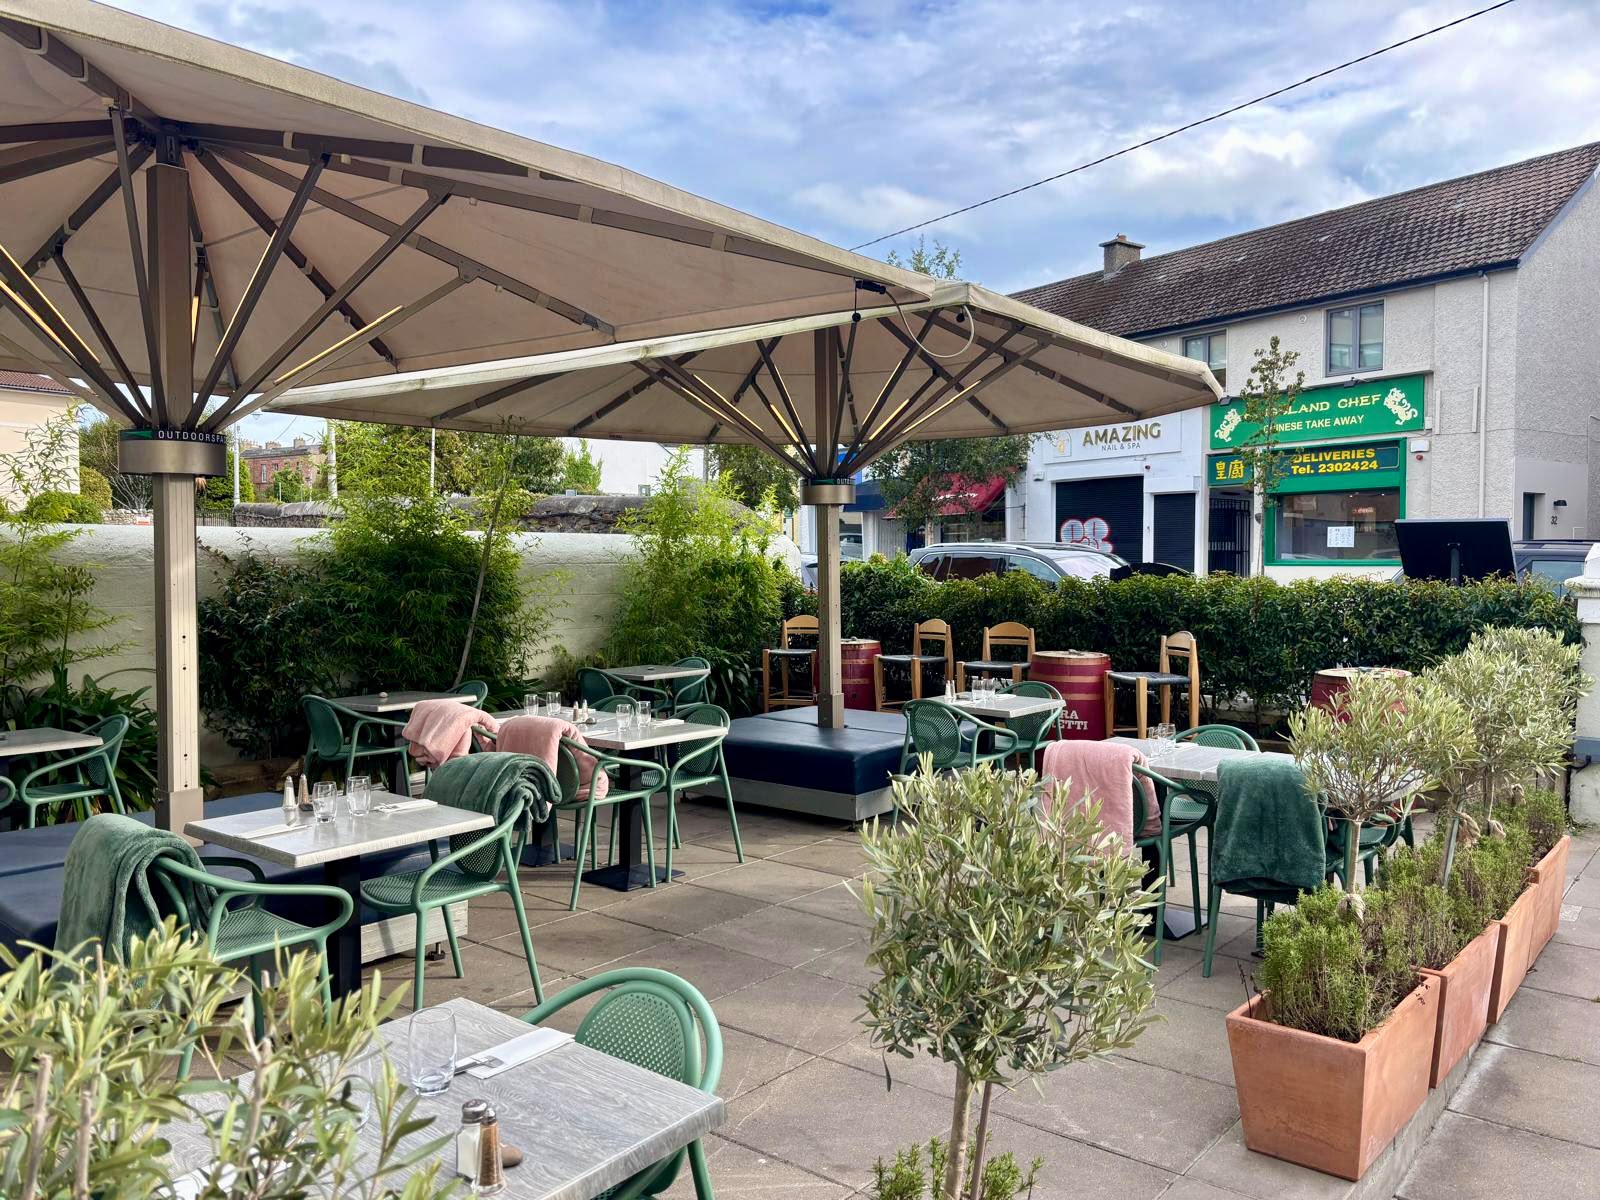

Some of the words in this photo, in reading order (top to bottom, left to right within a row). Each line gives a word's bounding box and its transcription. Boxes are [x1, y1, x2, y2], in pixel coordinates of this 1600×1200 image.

[1337, 394, 1382, 409] CHEF
[1263, 421, 1303, 434] CINESE
[1305, 418, 1331, 429] TAKE
[1333, 414, 1365, 426] AWAY
[1082, 422, 1161, 446] AMAZING
[1127, 442, 1141, 450] SPA
[1292, 448, 1375, 463] DELIVERIES
[1291, 464, 1315, 475] Tel.
[1318, 460, 1379, 474] 2302424
[1551, 516, 1558, 525] 32
